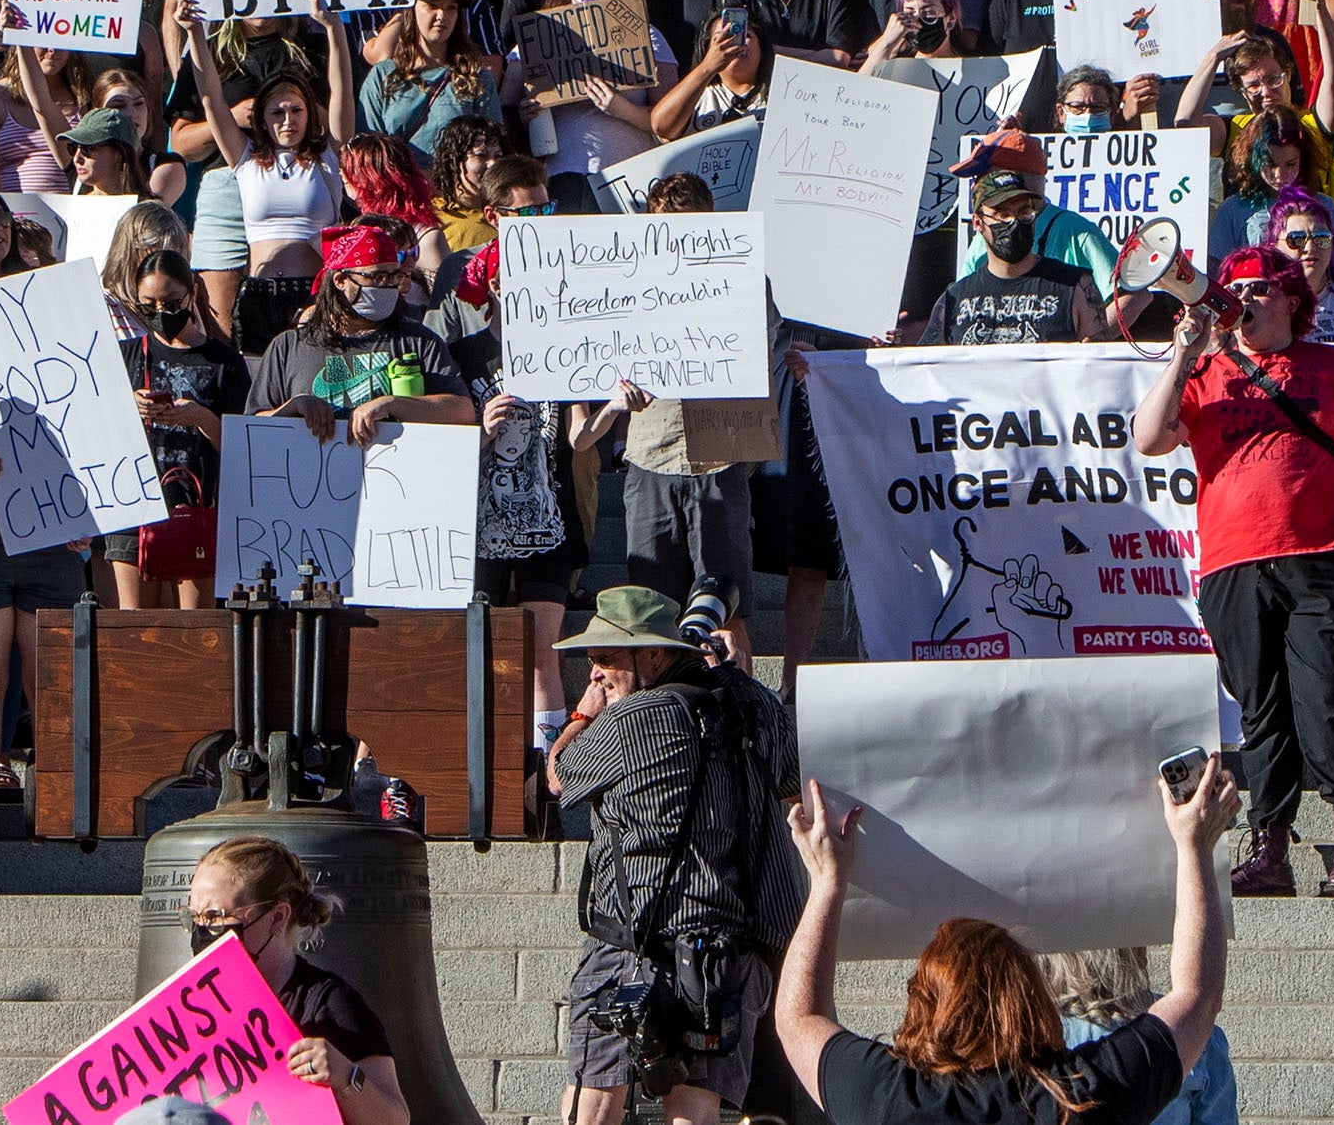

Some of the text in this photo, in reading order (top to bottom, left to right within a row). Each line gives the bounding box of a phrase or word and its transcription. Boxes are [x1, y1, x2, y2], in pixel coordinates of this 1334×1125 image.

[36, 10, 122, 39] WOMEN
[518, 5, 609, 63] FORCED
[684, 326, 739, 351] the
[910, 410, 1058, 454] LEGAL
[3, 453, 162, 538] CHOICE
[887, 466, 1128, 514] ONCE AND
[1082, 630, 1135, 648] PARTY
